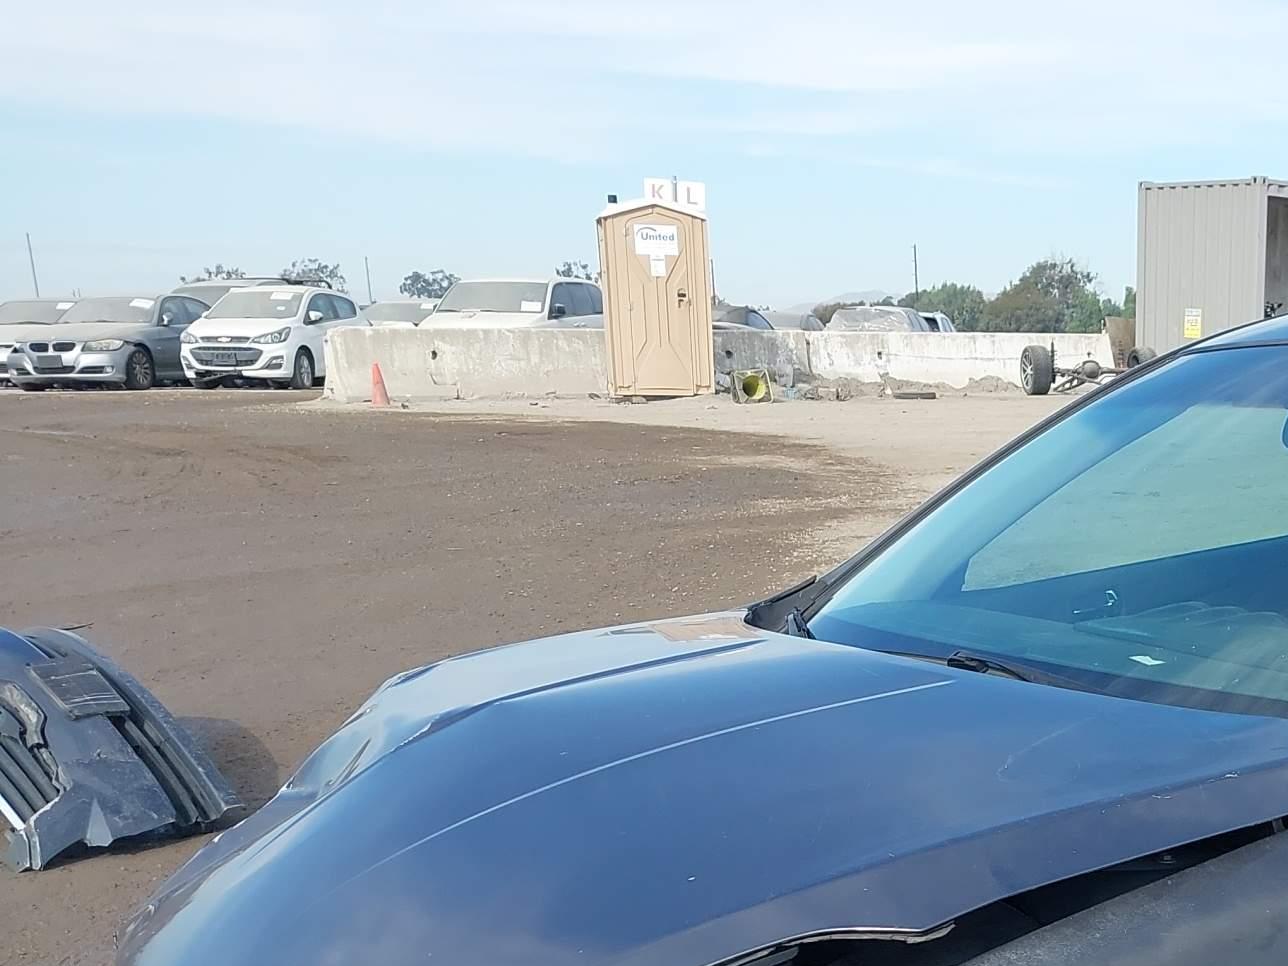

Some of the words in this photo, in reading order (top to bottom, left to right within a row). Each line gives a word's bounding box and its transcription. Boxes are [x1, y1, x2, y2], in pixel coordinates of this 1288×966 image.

[651, 183, 664, 200] K
[686, 186, 699, 206] L
[640, 231, 675, 242] United
